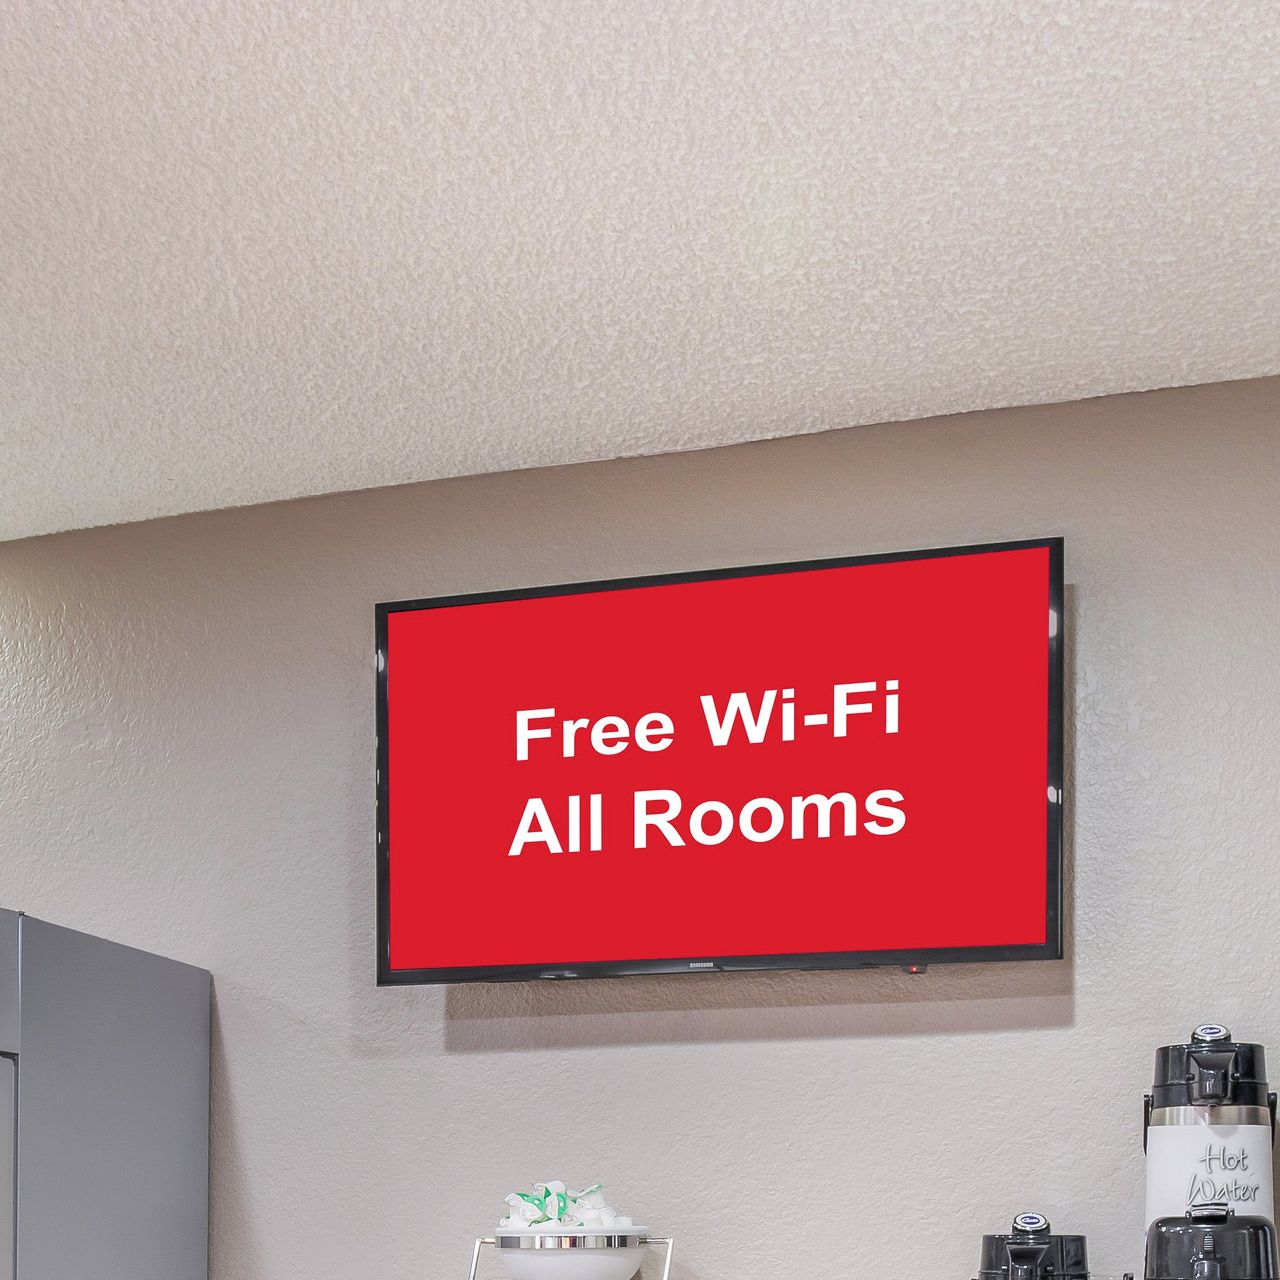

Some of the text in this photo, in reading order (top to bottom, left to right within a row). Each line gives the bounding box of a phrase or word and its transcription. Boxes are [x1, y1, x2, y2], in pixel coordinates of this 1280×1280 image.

[516, 680, 899, 761] Free Wi-Fi
[508, 788, 907, 857] All Rooms
[1198, 1143, 1249, 1174] Hot
[1186, 1173, 1260, 1206] Water
